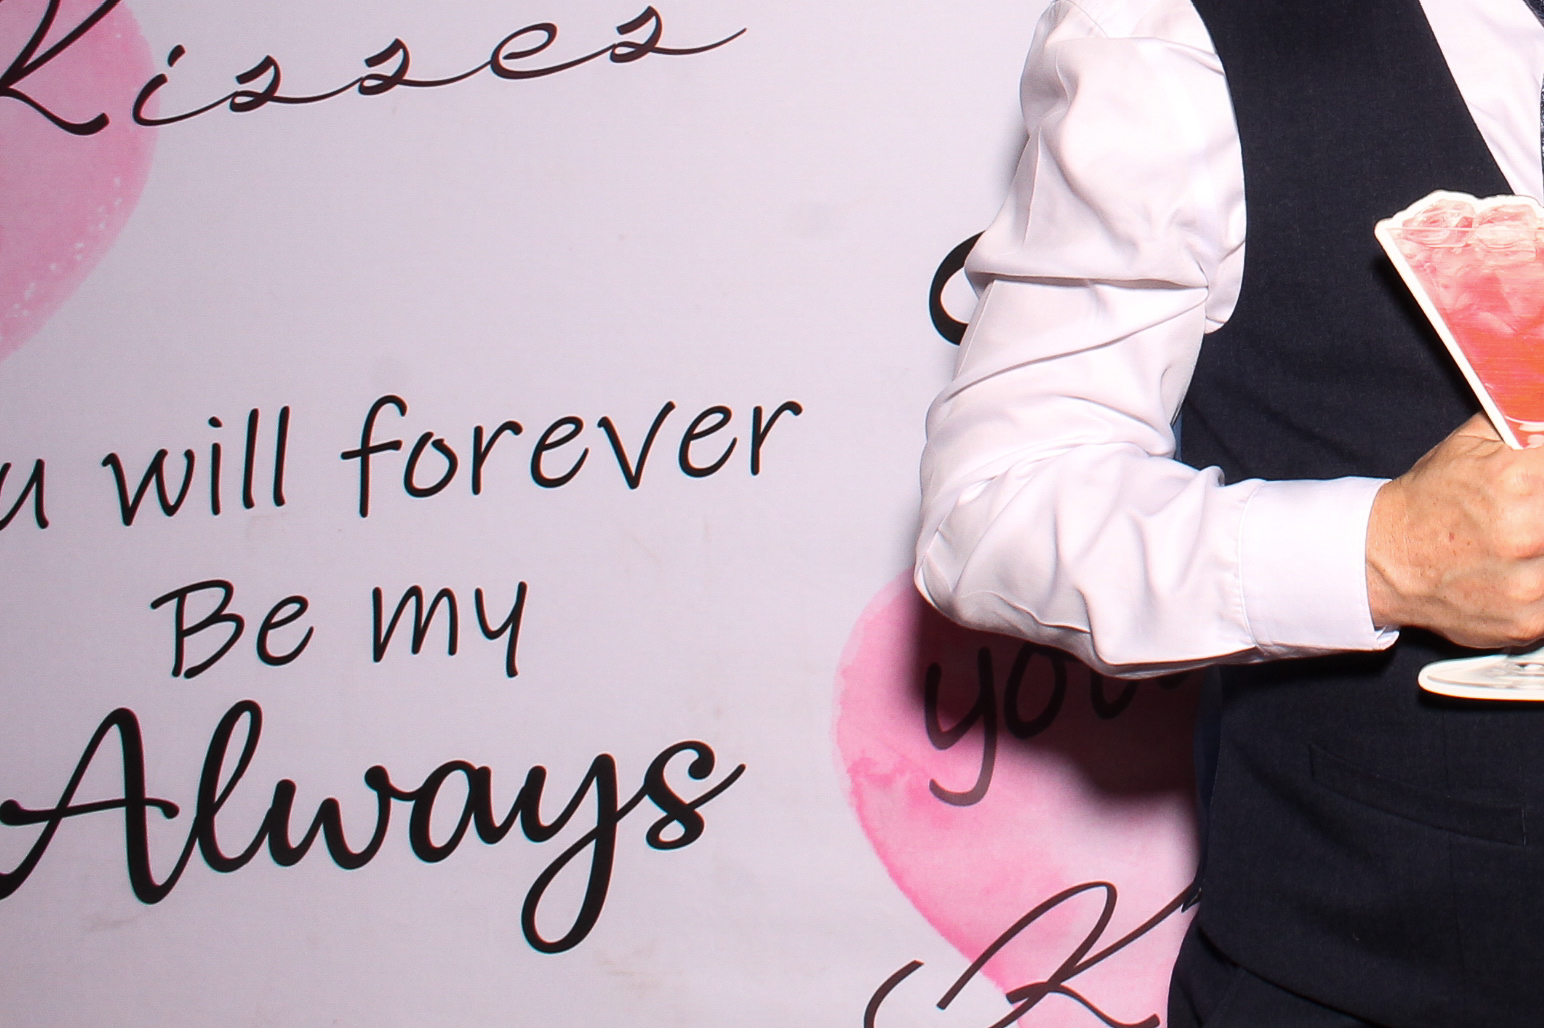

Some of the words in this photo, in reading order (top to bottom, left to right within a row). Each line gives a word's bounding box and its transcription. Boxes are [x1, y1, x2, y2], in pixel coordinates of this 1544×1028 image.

[102, 406, 289, 526] will
[341, 395, 802, 518] forever
[151, 580, 313, 679] Be
[373, 582, 527, 678] my
[0, 700, 745, 954] Always
